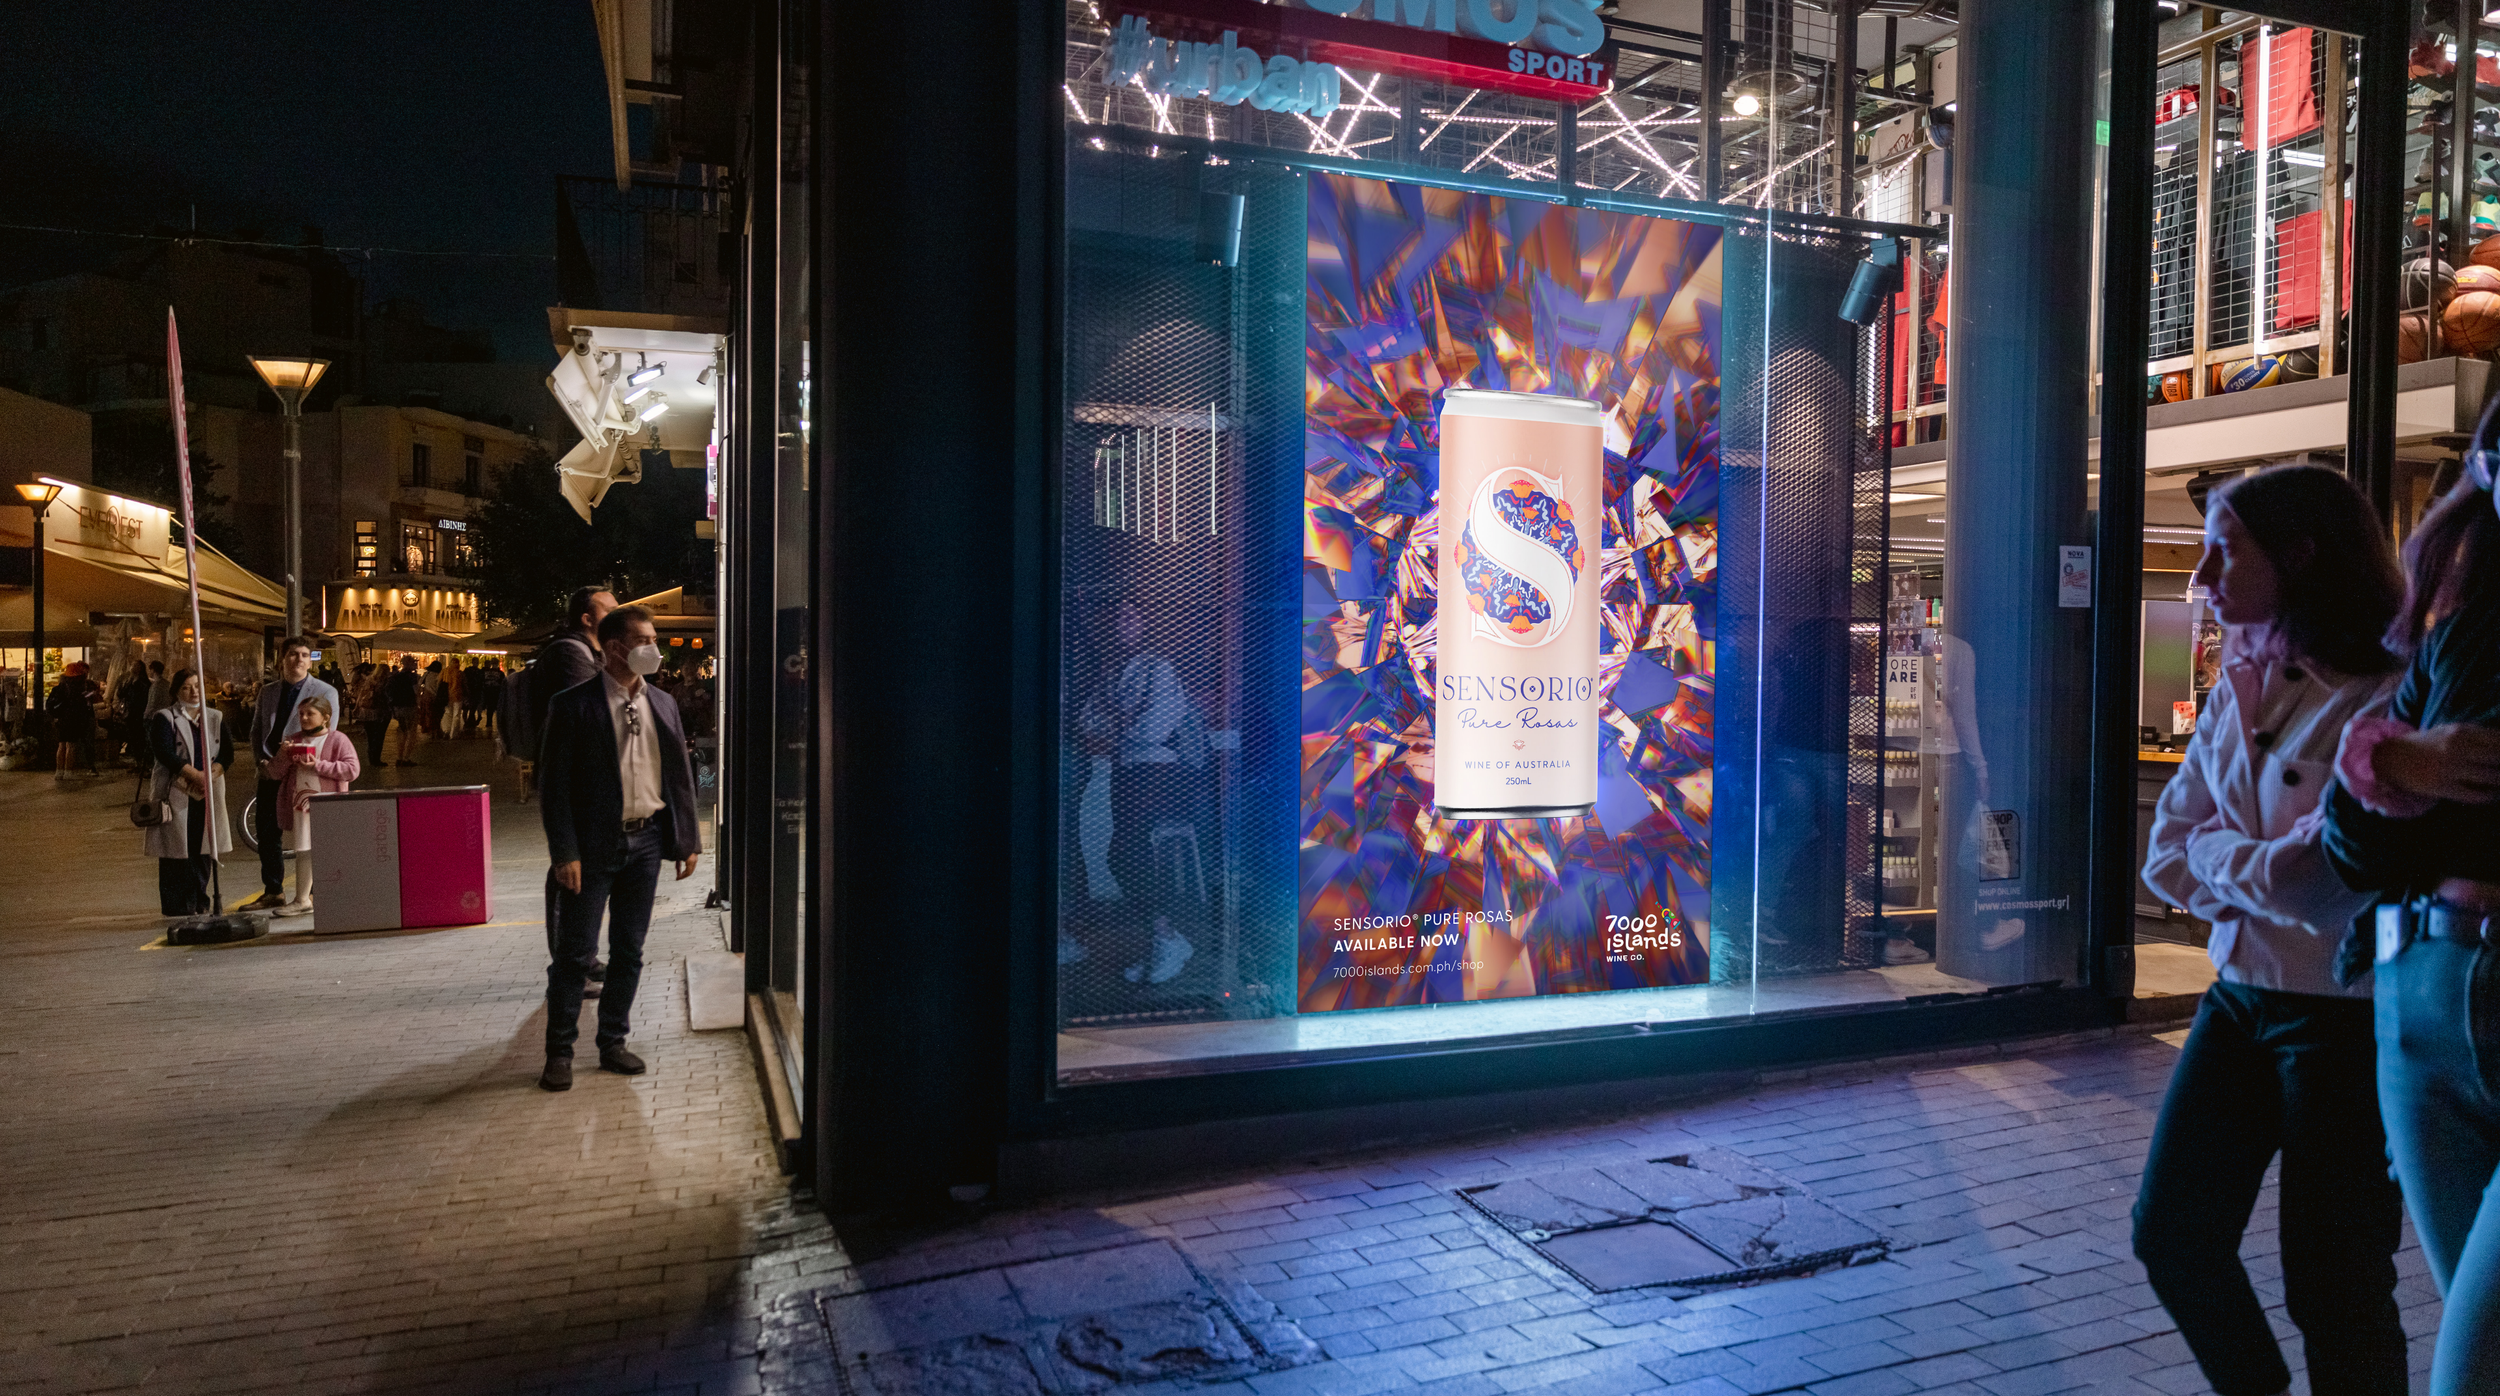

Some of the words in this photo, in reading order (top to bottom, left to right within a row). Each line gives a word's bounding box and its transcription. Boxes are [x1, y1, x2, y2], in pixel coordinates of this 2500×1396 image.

[1105, 14, 1341, 118] #urban
[1508, 48, 1604, 86] SPORT
[79, 505, 143, 540] EVEREST
[1890, 659, 1917, 670] ORE
[1889, 671, 1917, 682] ARE
[1457, 707, 1512, 729] Pure
[1516, 706, 1579, 729] Rosas
[1464, 760, 1492, 770] WINE
[1495, 760, 1511, 770] OF
[1515, 759, 1571, 770] AUSTRALIA
[1505, 776, 1532, 786] 250mL
[1986, 813, 2013, 826] SHOP
[375, 807, 391, 863] garbage
[1987, 827, 2005, 838] TAX
[1424, 912, 1460, 927] PURE
[1465, 909, 1513, 924] ROSAS
[1605, 914, 1658, 933] 7000
[1333, 935, 1415, 953] AVAILABLE
[1420, 933, 1460, 948] NOW
[1606, 954, 1628, 963] WINE
[1333, 959, 1484, 978] 7000islands.com.ph/shop
